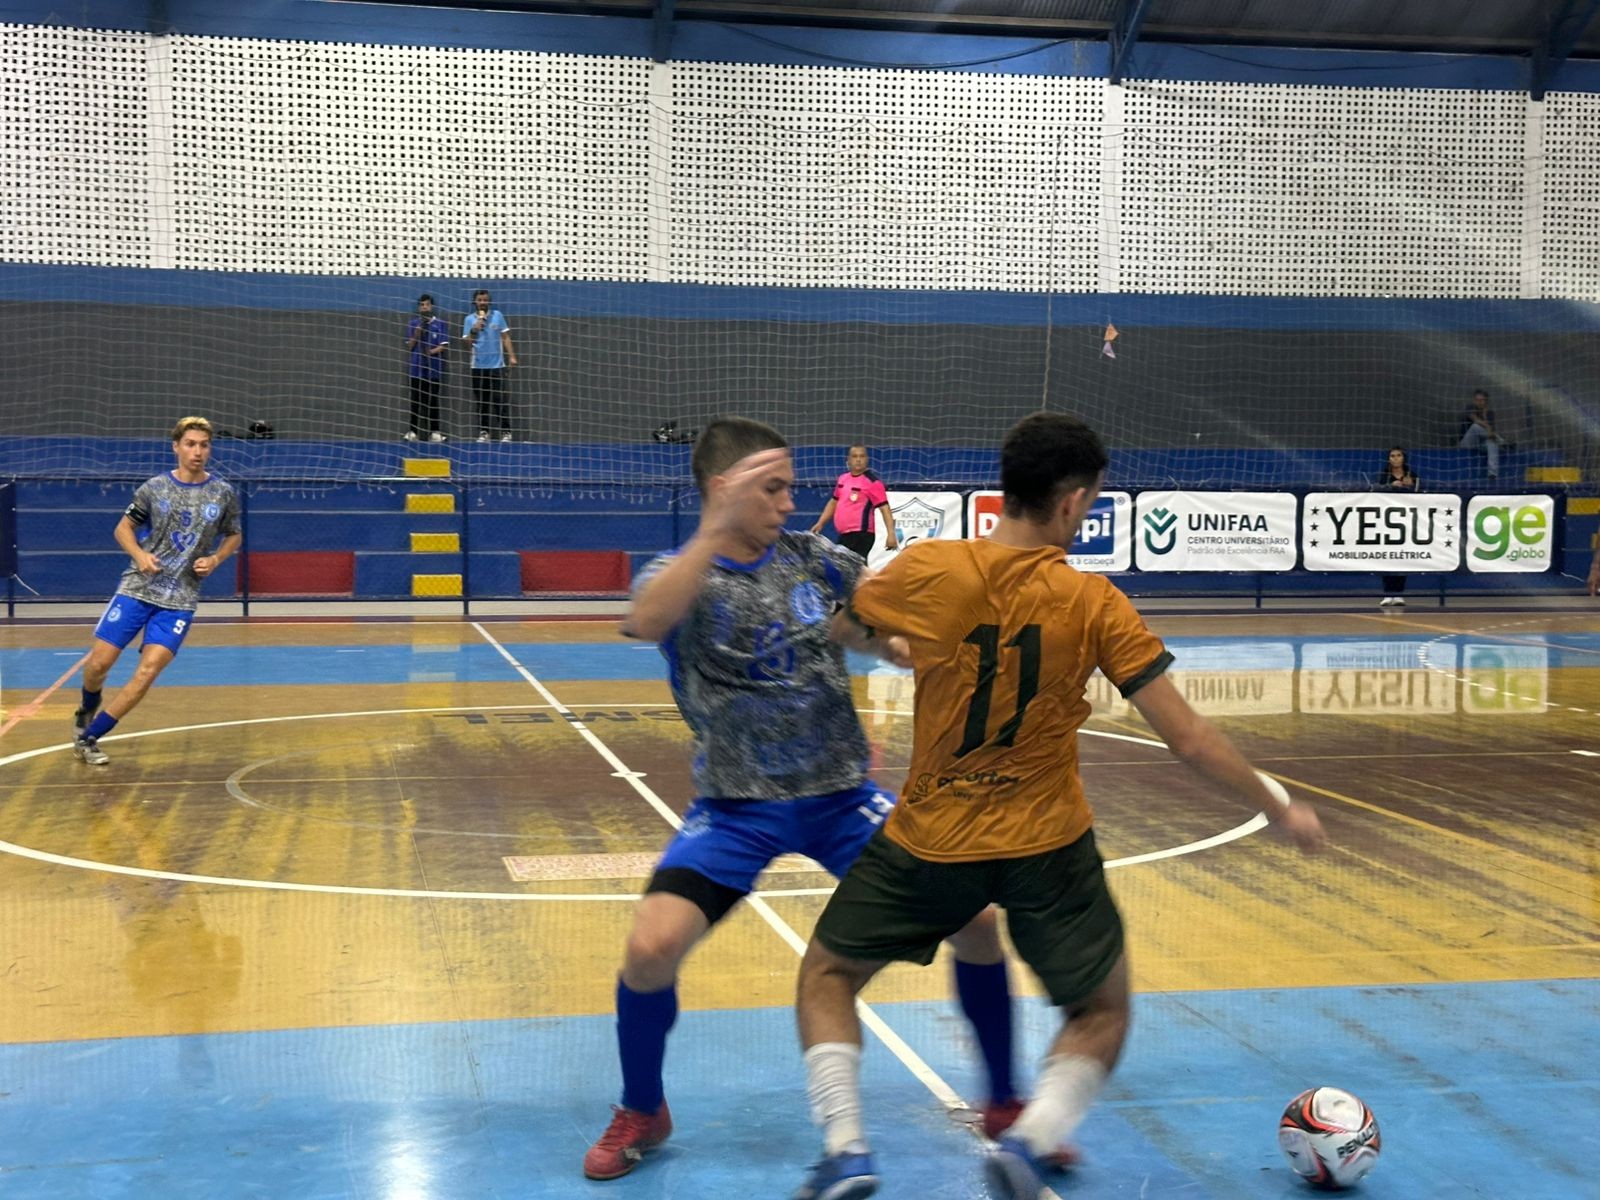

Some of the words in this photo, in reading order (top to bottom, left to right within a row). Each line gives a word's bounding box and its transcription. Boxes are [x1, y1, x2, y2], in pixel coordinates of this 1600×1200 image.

[896, 518, 934, 528] FUTSAL
[1187, 513, 1269, 532] UNIFAA
[1325, 506, 1437, 545] YESU
[1187, 536, 1223, 545] CENTRO
[1224, 535, 1290, 546] UNIVERSITÁRIO
[1472, 506, 1547, 561] ge
[1215, 547, 1226, 555] de
[1328, 551, 1388, 560] MOBILIDADE
[1389, 549, 1432, 560] ELÉTRICA
[172, 618, 187, 635] 5
[953, 623, 1042, 758] 11
